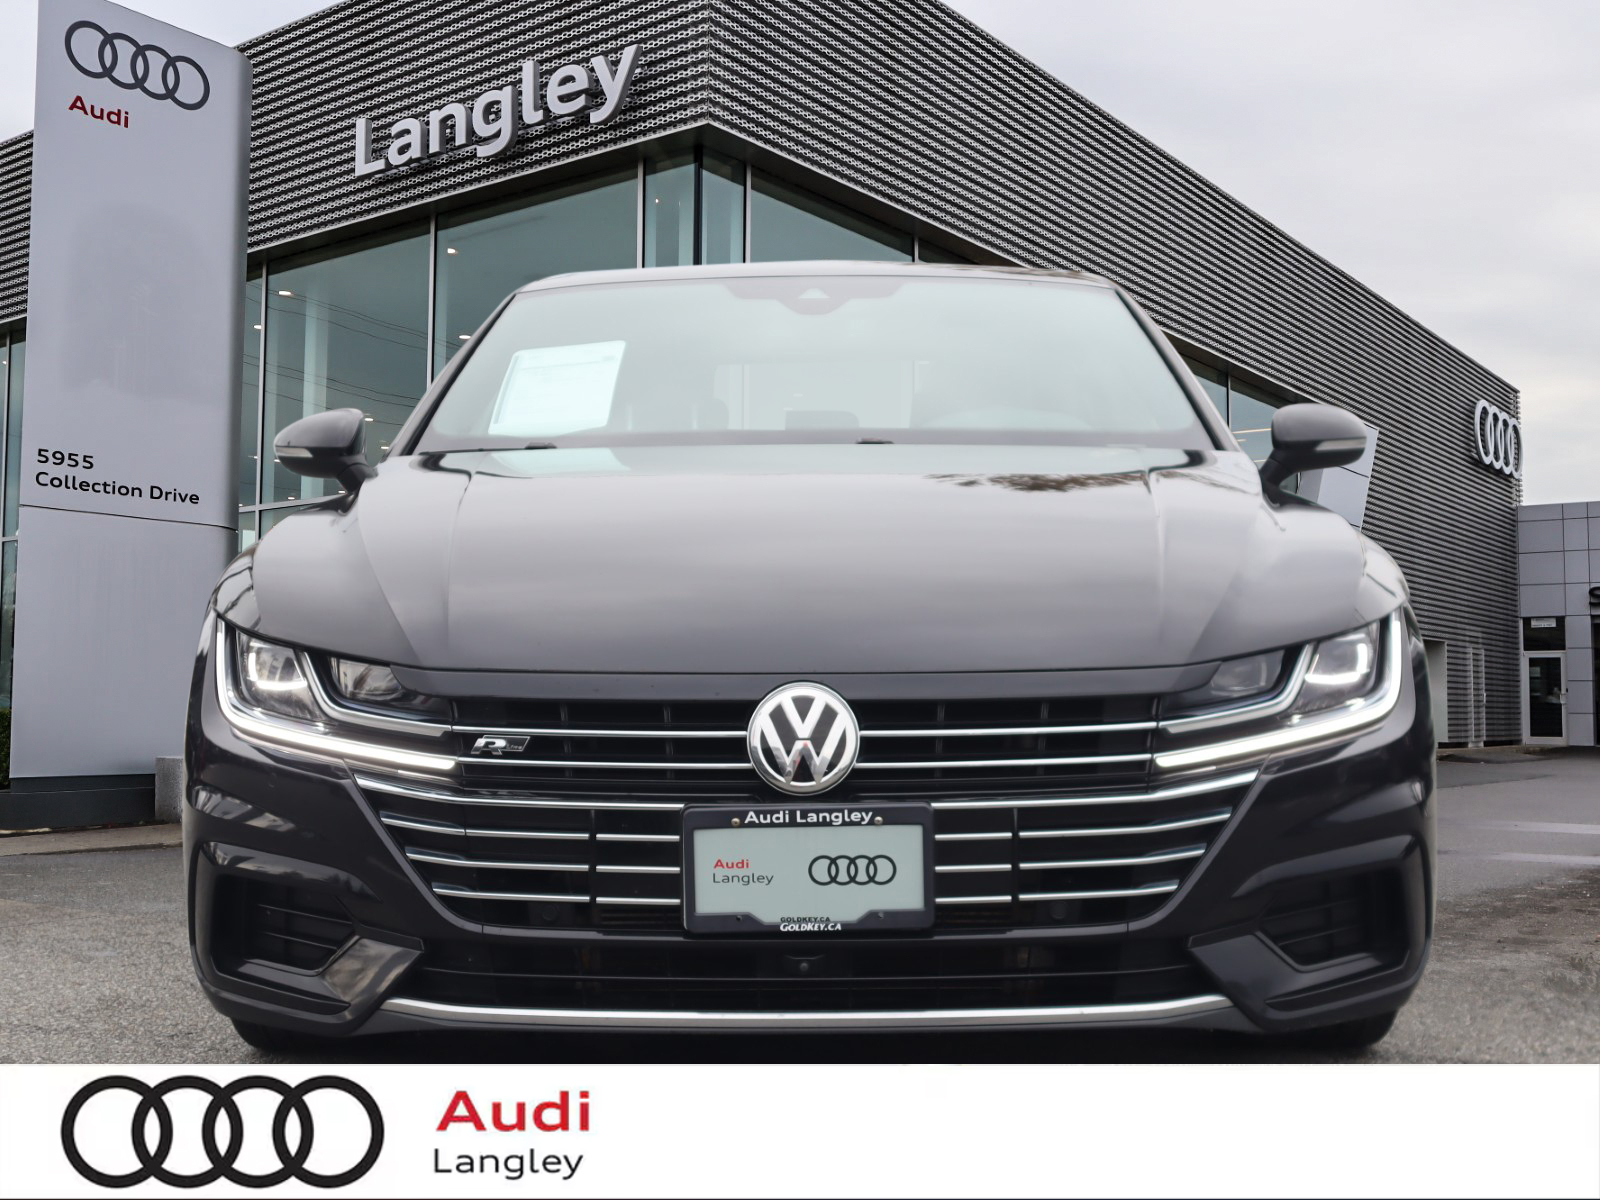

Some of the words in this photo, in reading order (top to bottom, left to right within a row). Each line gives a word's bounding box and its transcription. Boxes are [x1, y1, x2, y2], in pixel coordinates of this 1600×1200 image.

[68, 94, 130, 129] Audi
[354, 43, 642, 177] Langley
[36, 447, 95, 470] 5955
[35, 470, 143, 498] Collection
[149, 484, 200, 505] Drive
[744, 809, 790, 824] Audi
[796, 809, 873, 826] Langley
[712, 858, 750, 870] Audi
[712, 872, 774, 886] Langley
